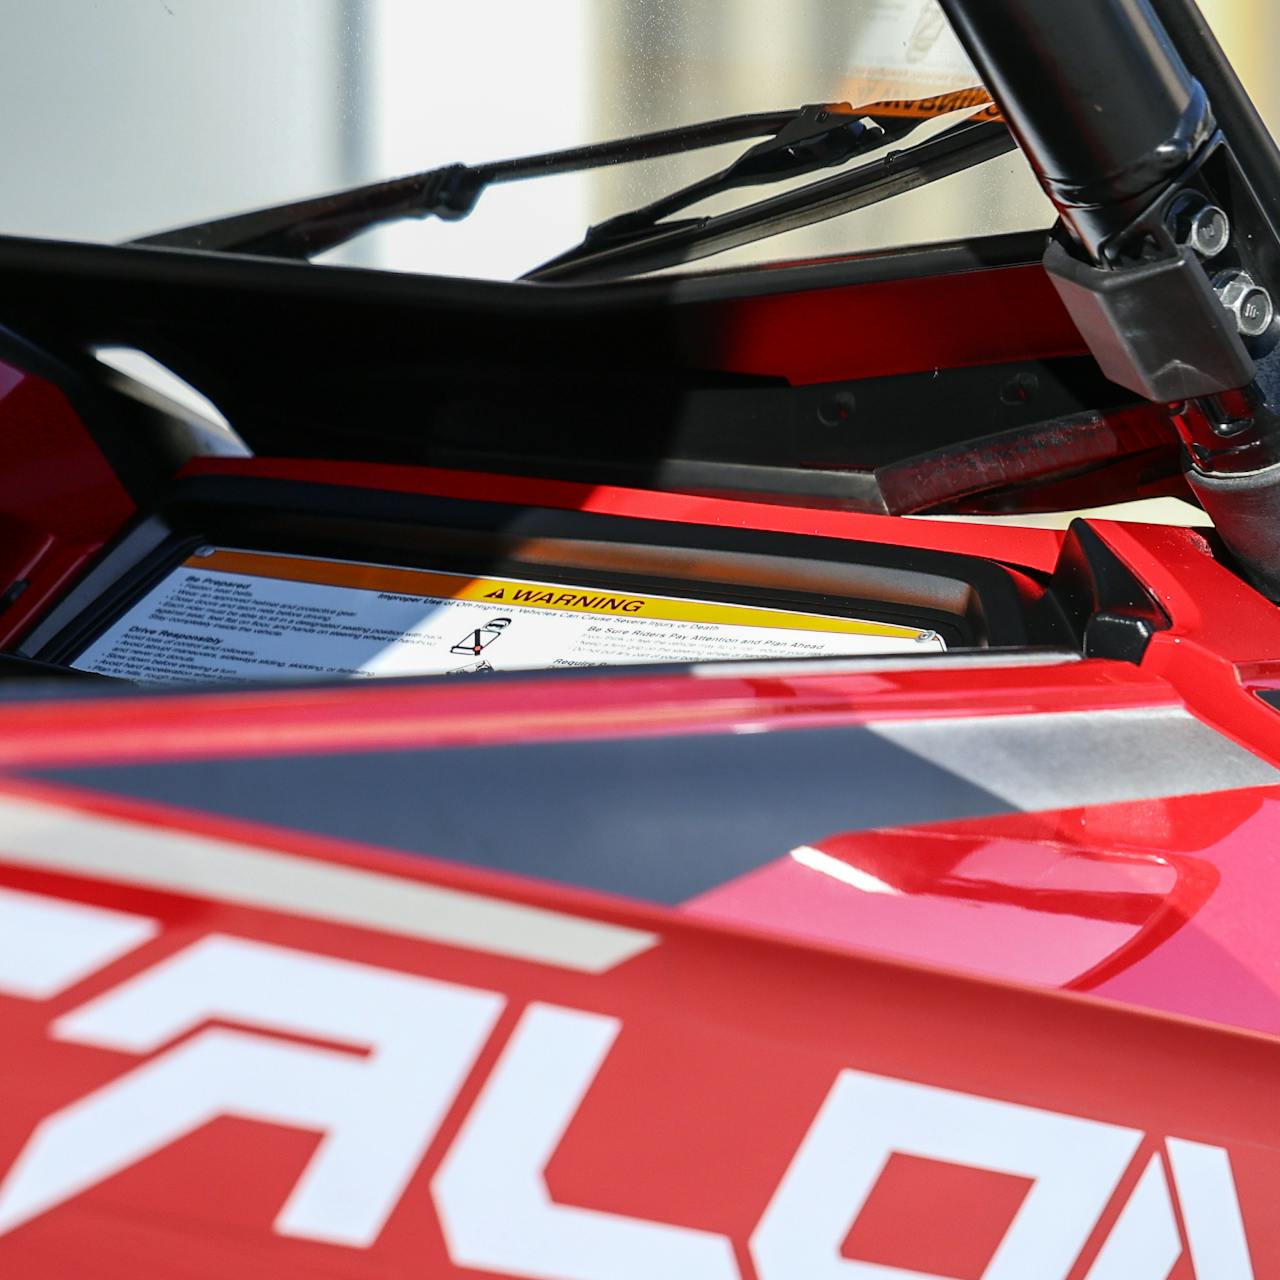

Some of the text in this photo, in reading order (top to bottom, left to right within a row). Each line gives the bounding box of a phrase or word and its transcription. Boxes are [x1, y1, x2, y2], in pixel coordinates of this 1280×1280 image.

[185, 575, 252, 589] Be Prepared
[512, 589, 645, 612] WARNING
[377, 593, 423, 604] Improper
[423, 598, 442, 606] Use
[518, 608, 557, 617] Vehicles
[559, 612, 579, 620] Can
[581, 614, 612, 622] Cause
[614, 618, 648, 626] Severe
[648, 621, 675, 630] Injury
[689, 623, 720, 631] Death
[129, 625, 223, 645] Drive Responsibly
[631, 630, 666, 638] Riders
[668, 633, 689, 641] Pay
[691, 635, 739, 643] Attention
[762, 639, 789, 648] Plan
[790, 642, 825, 650] Ahead
[553, 658, 599, 667] Require
